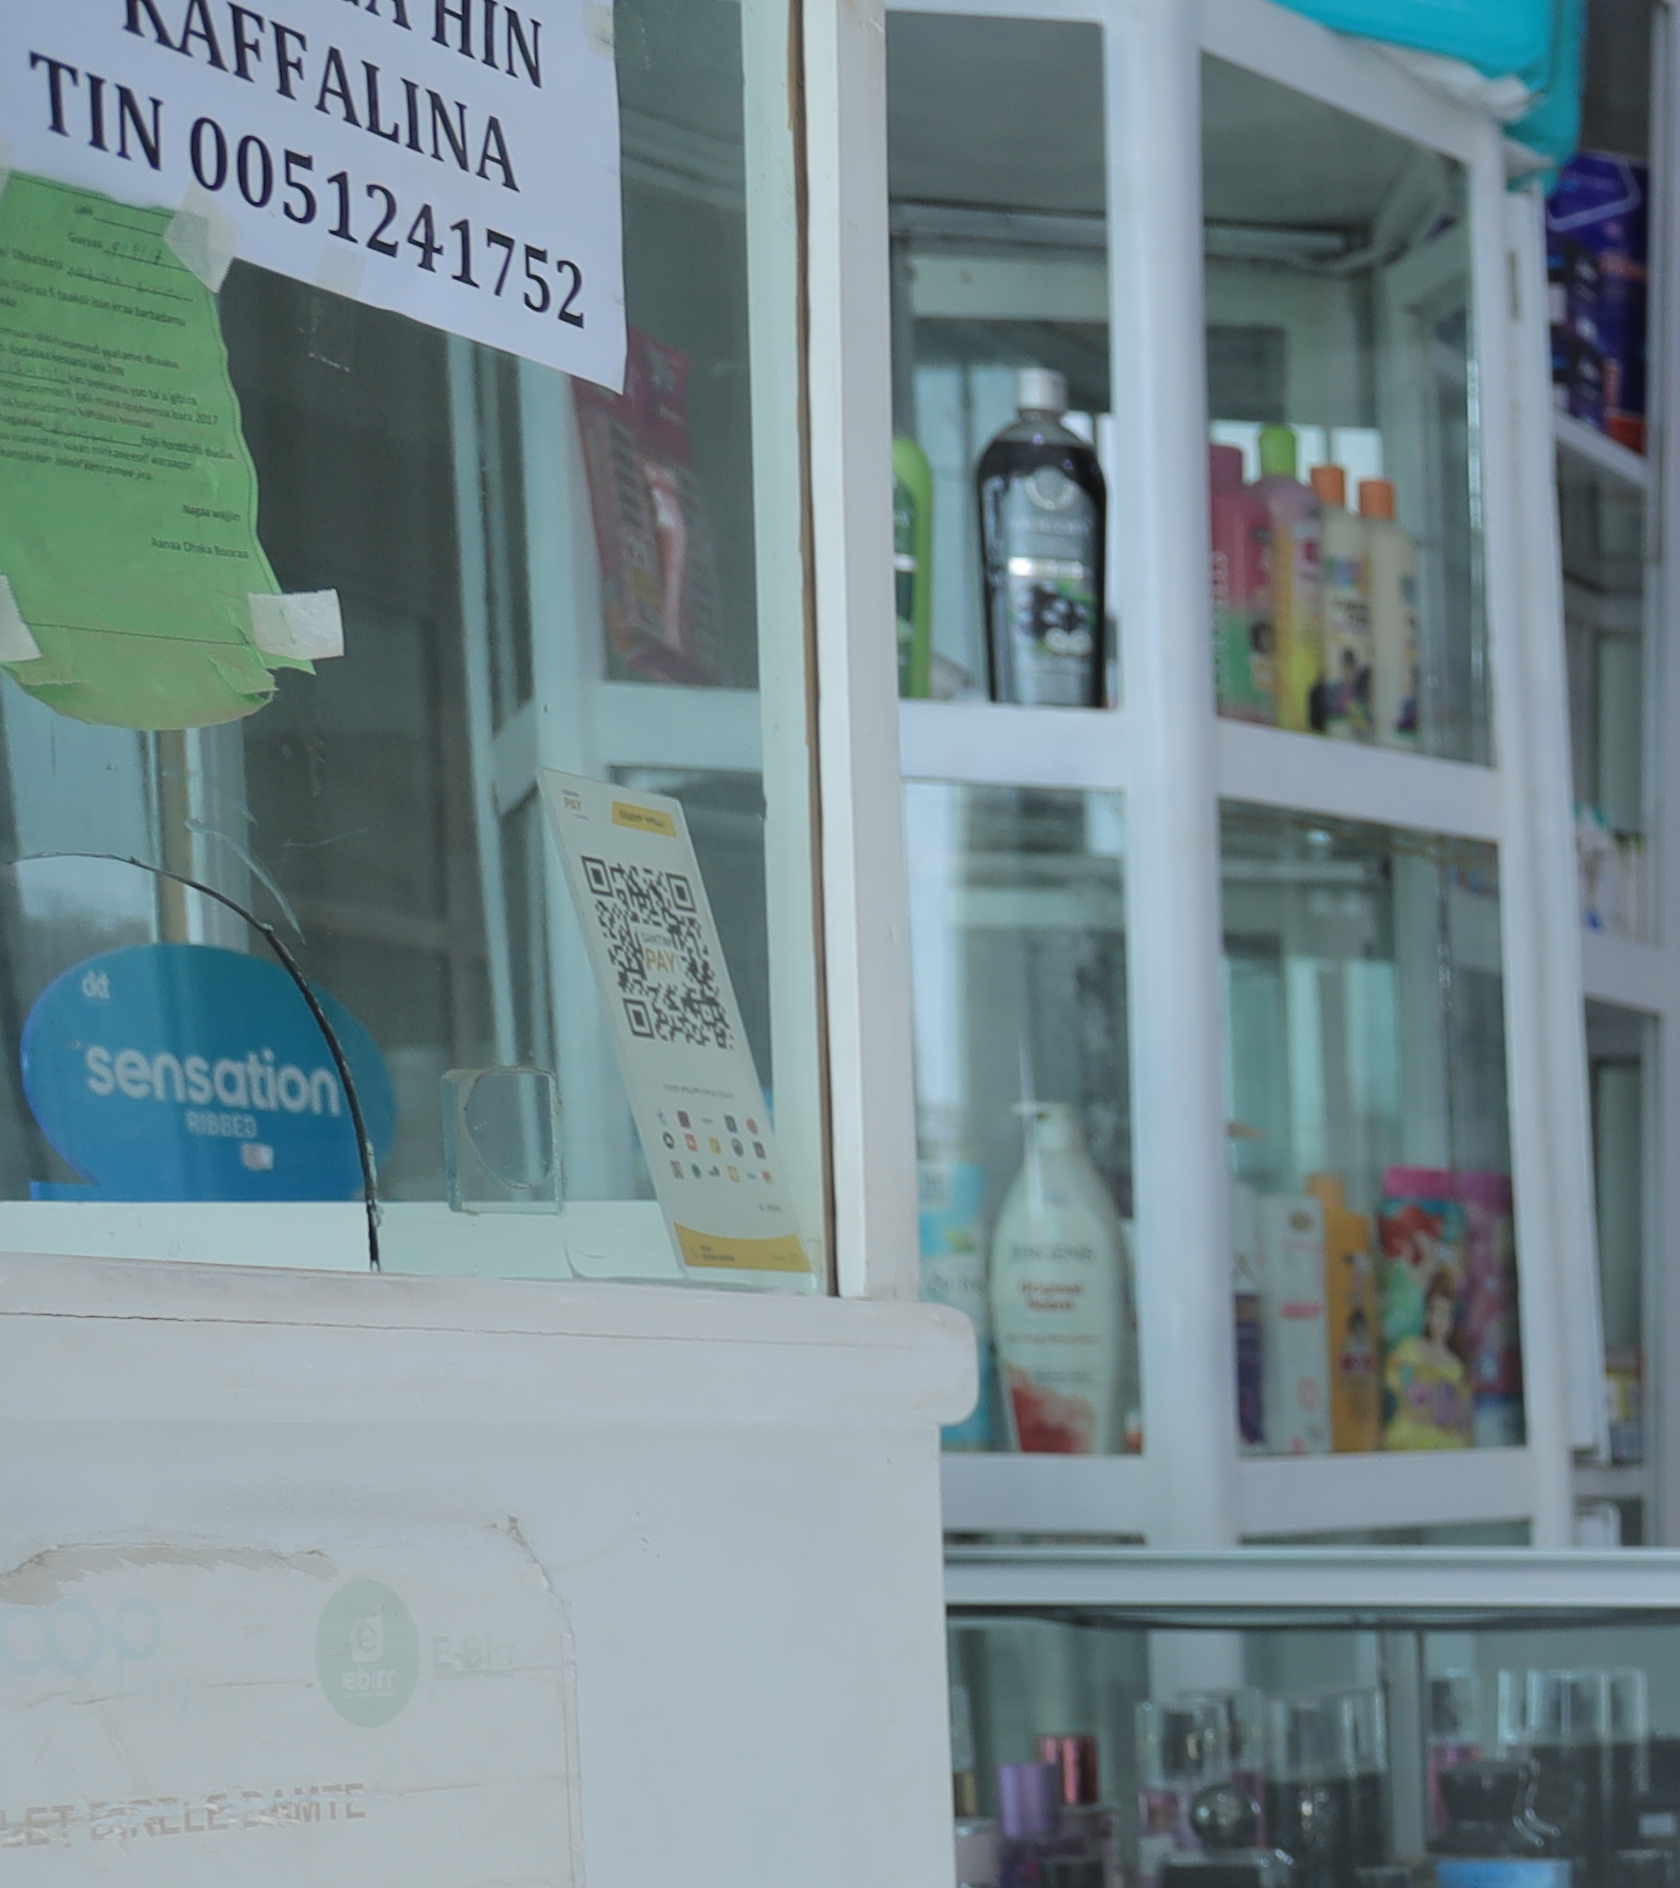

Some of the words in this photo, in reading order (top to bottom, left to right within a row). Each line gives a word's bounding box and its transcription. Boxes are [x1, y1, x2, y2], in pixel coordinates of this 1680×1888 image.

[28, 50, 163, 171] TIN
[190, 116, 585, 329] 0051241752
[84, 1036, 342, 1117] sensation
